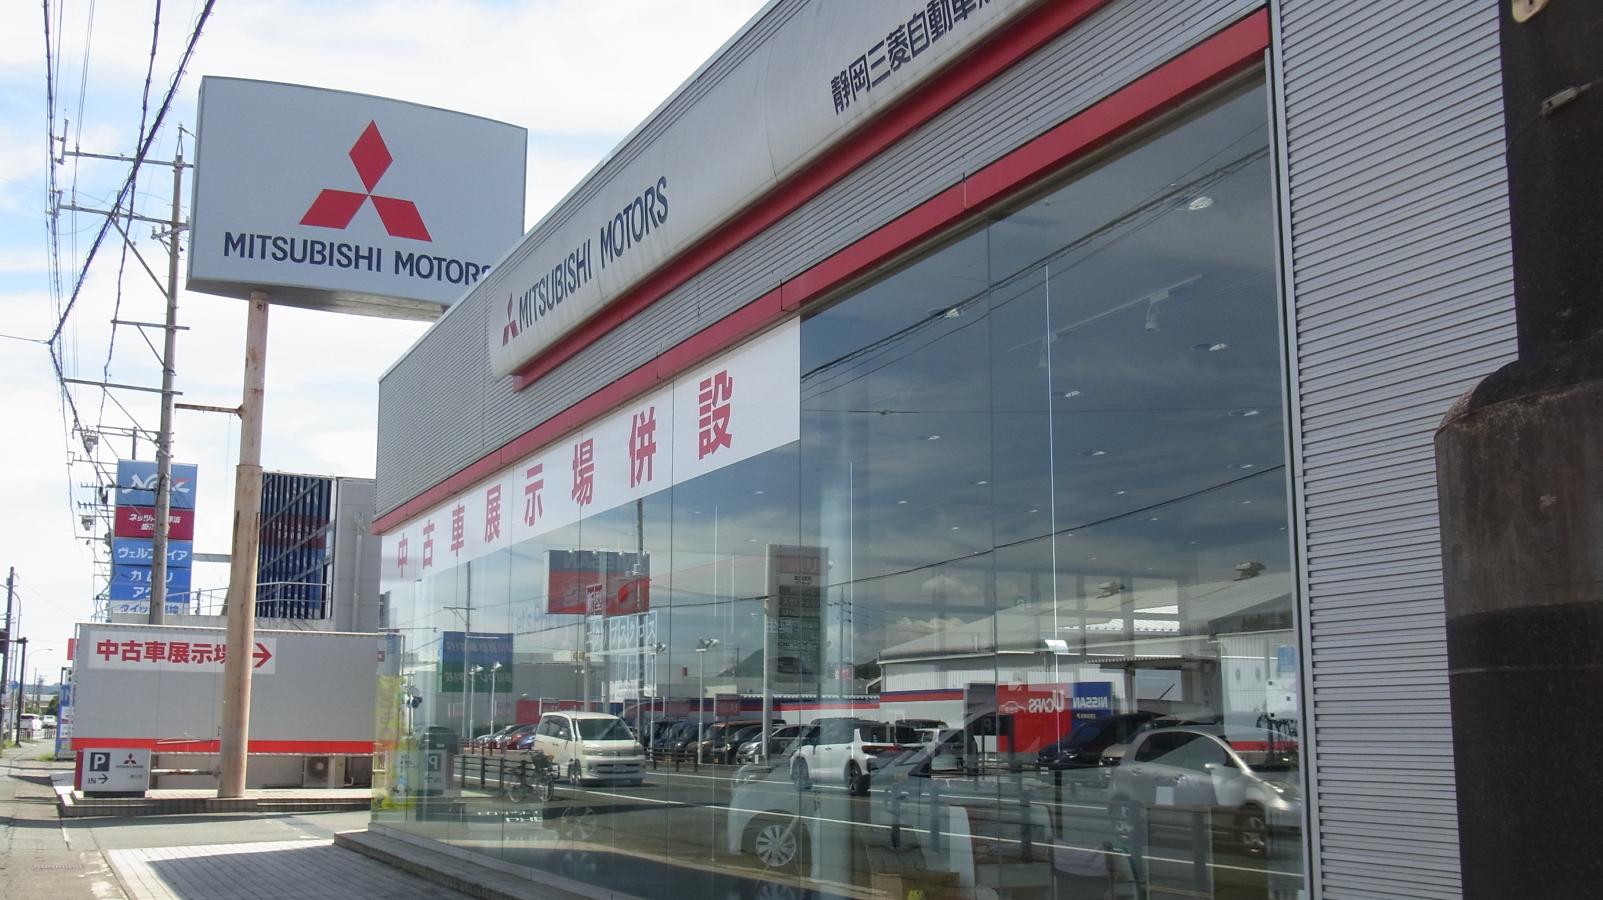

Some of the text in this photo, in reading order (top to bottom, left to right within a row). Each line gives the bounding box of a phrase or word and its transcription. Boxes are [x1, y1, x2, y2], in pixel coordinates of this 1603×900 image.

[223, 231, 382, 273] MITSUBISHI
[518, 175, 669, 333] MITSUBISHI MOTORS
[93, 754, 106, 770] P
